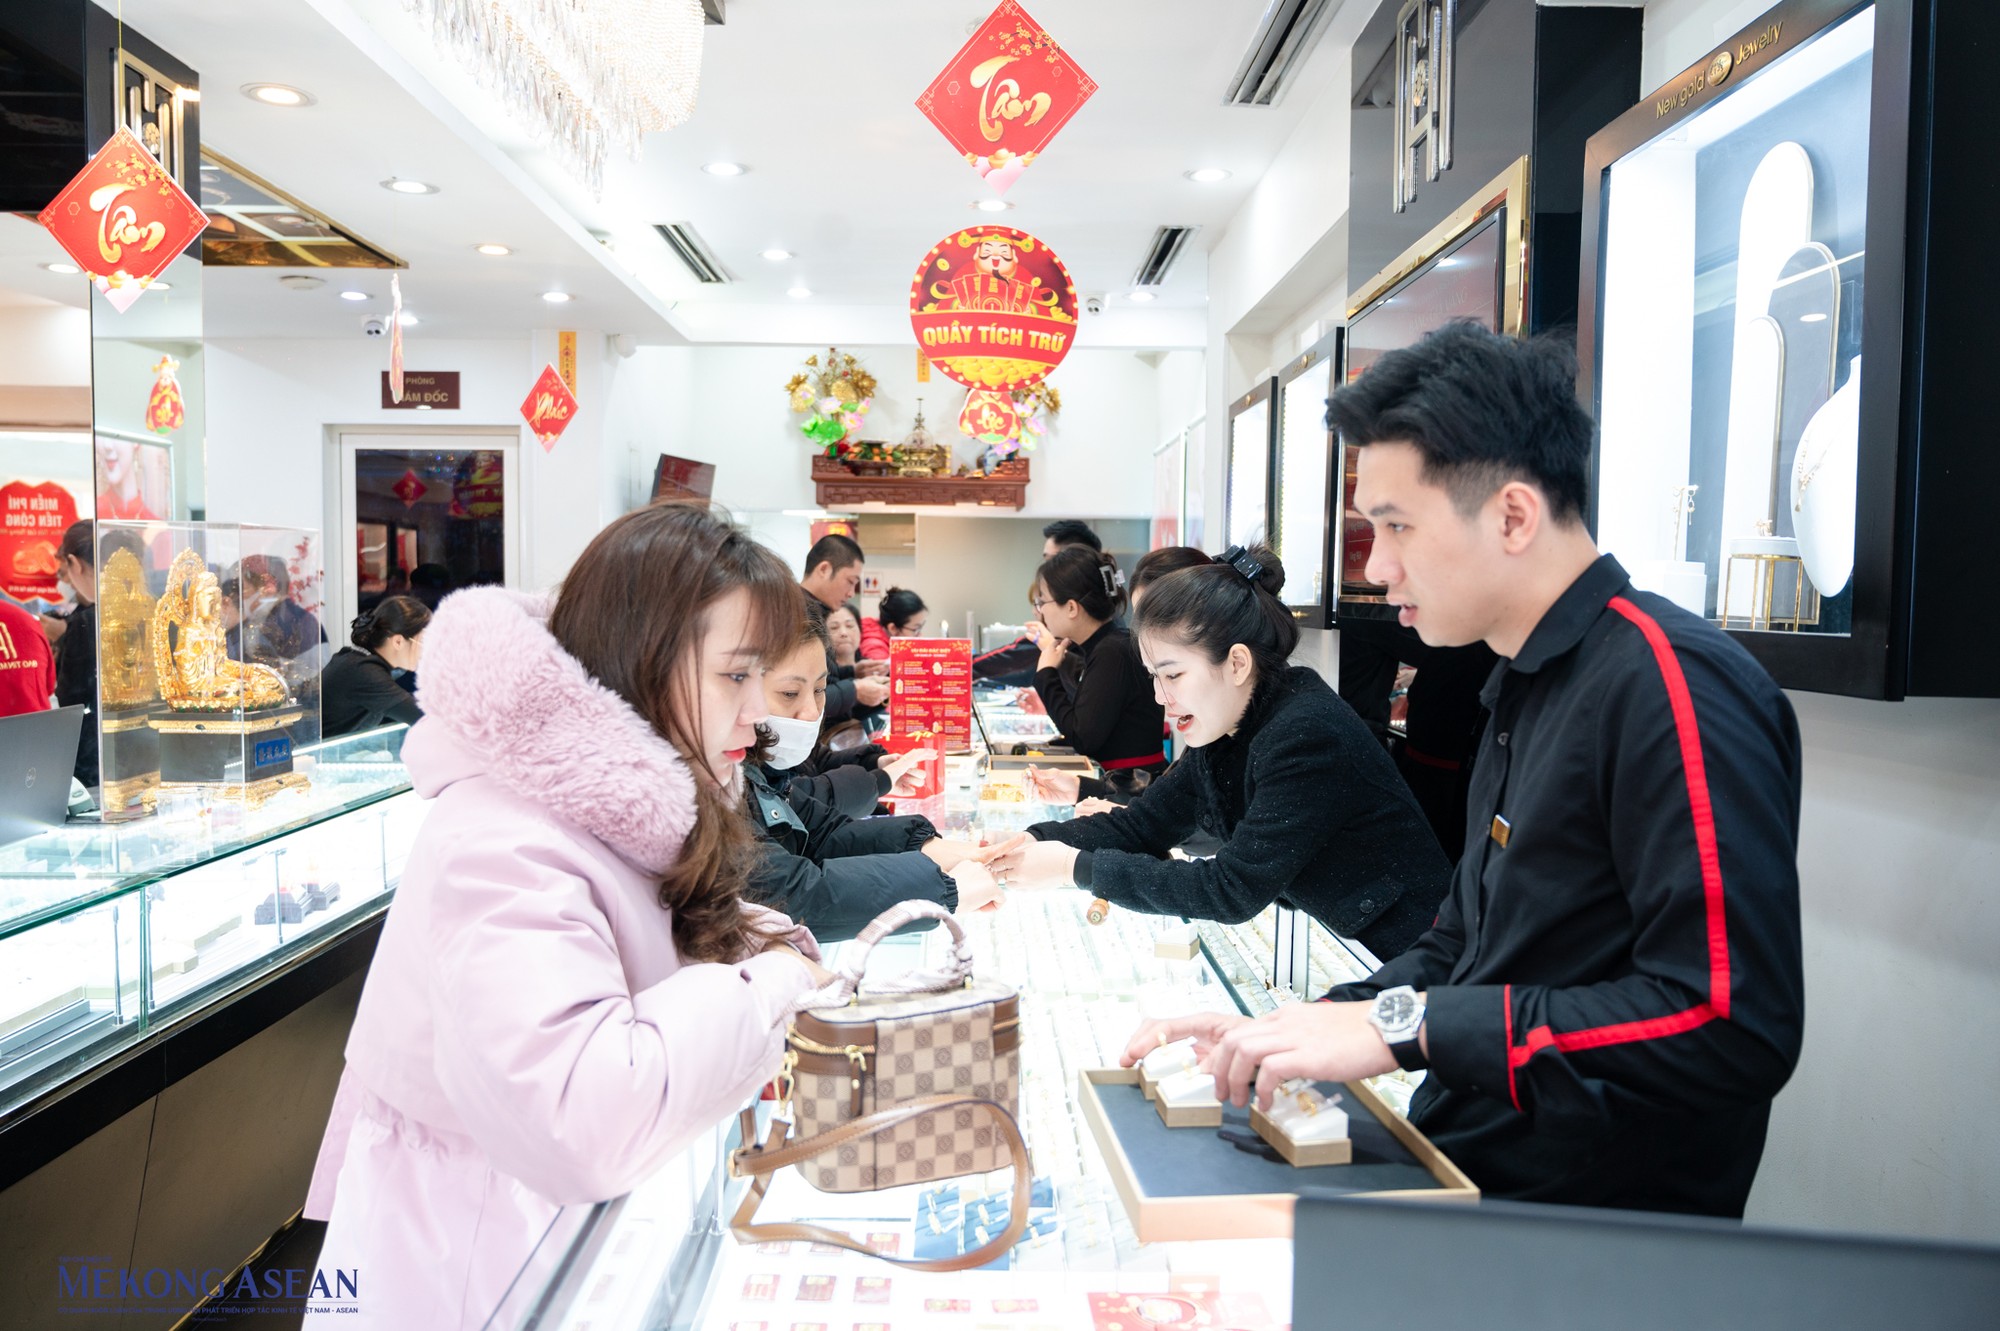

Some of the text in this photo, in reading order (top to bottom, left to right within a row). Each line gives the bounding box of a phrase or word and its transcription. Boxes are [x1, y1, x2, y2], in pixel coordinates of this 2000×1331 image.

[1656, 21, 1784, 119] New gold Jewelry
[923, 320, 1067, 353] QUẦY TÍCH TRỮ
[424, 389, 449, 402] ĐỐC
